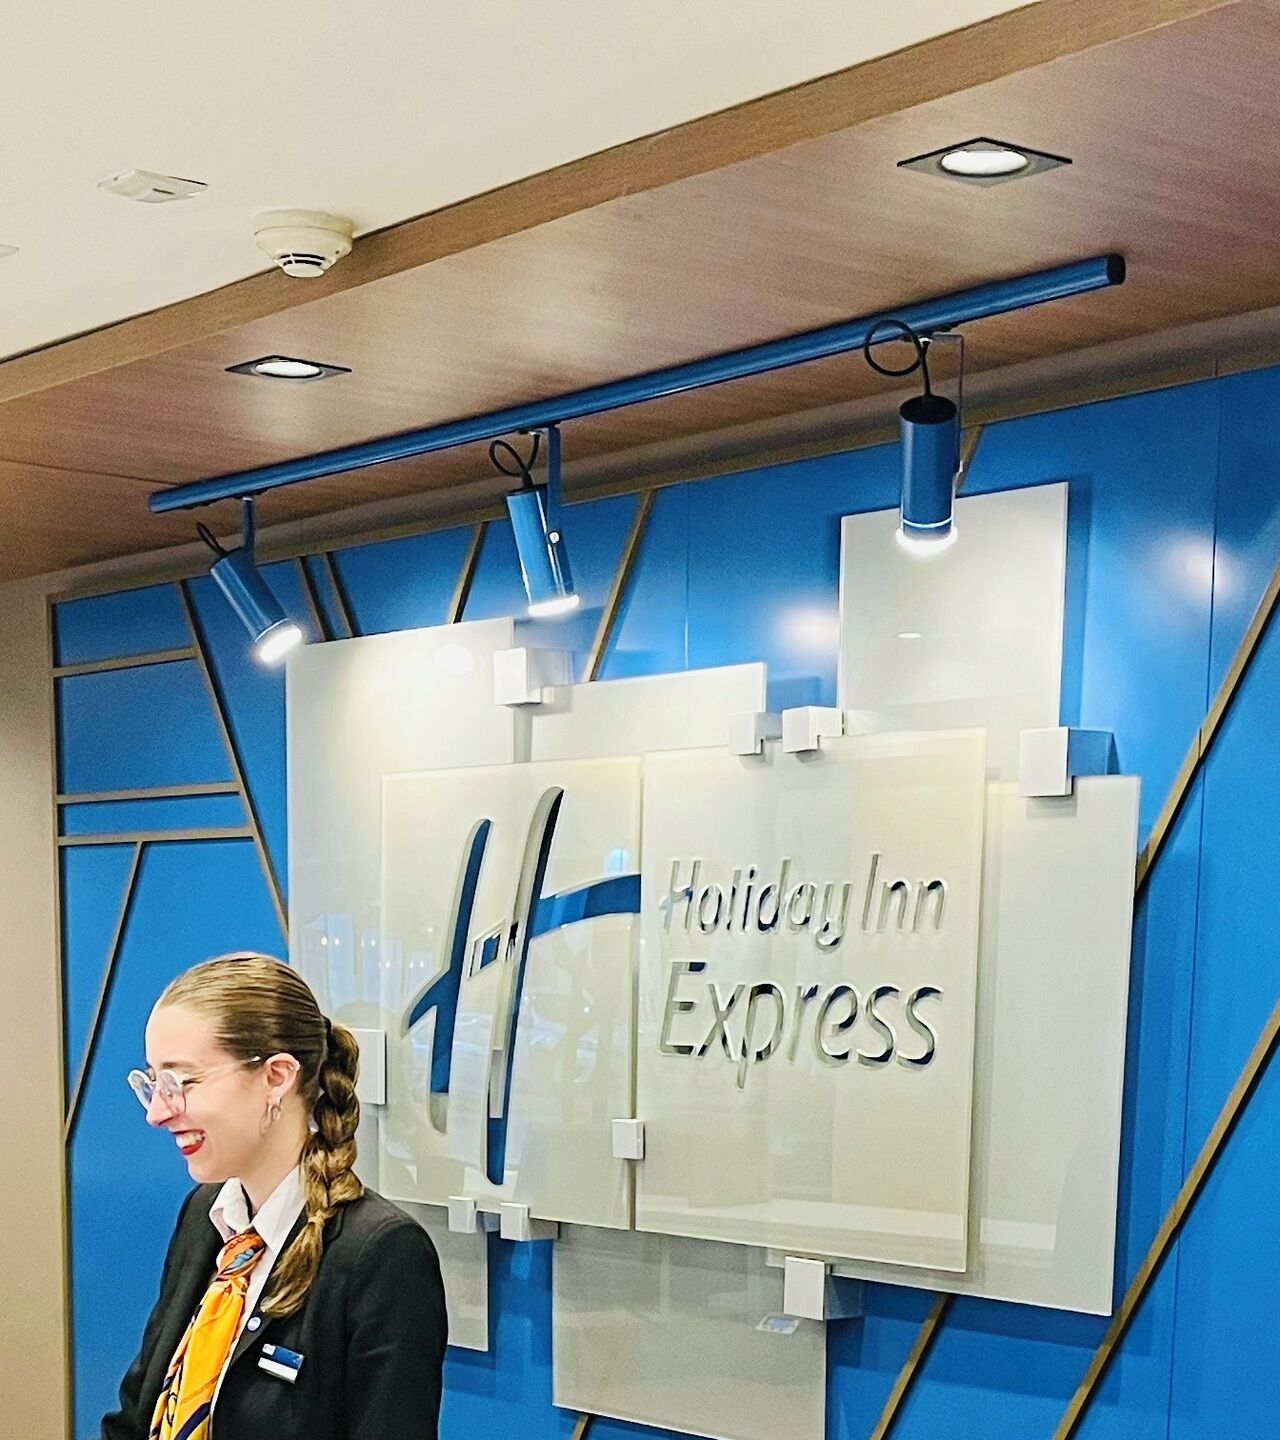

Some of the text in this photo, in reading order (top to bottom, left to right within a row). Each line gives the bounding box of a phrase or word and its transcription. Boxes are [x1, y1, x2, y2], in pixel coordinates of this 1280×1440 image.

[660, 852, 947, 953] Holiday Inn
[659, 961, 943, 1091] Express
